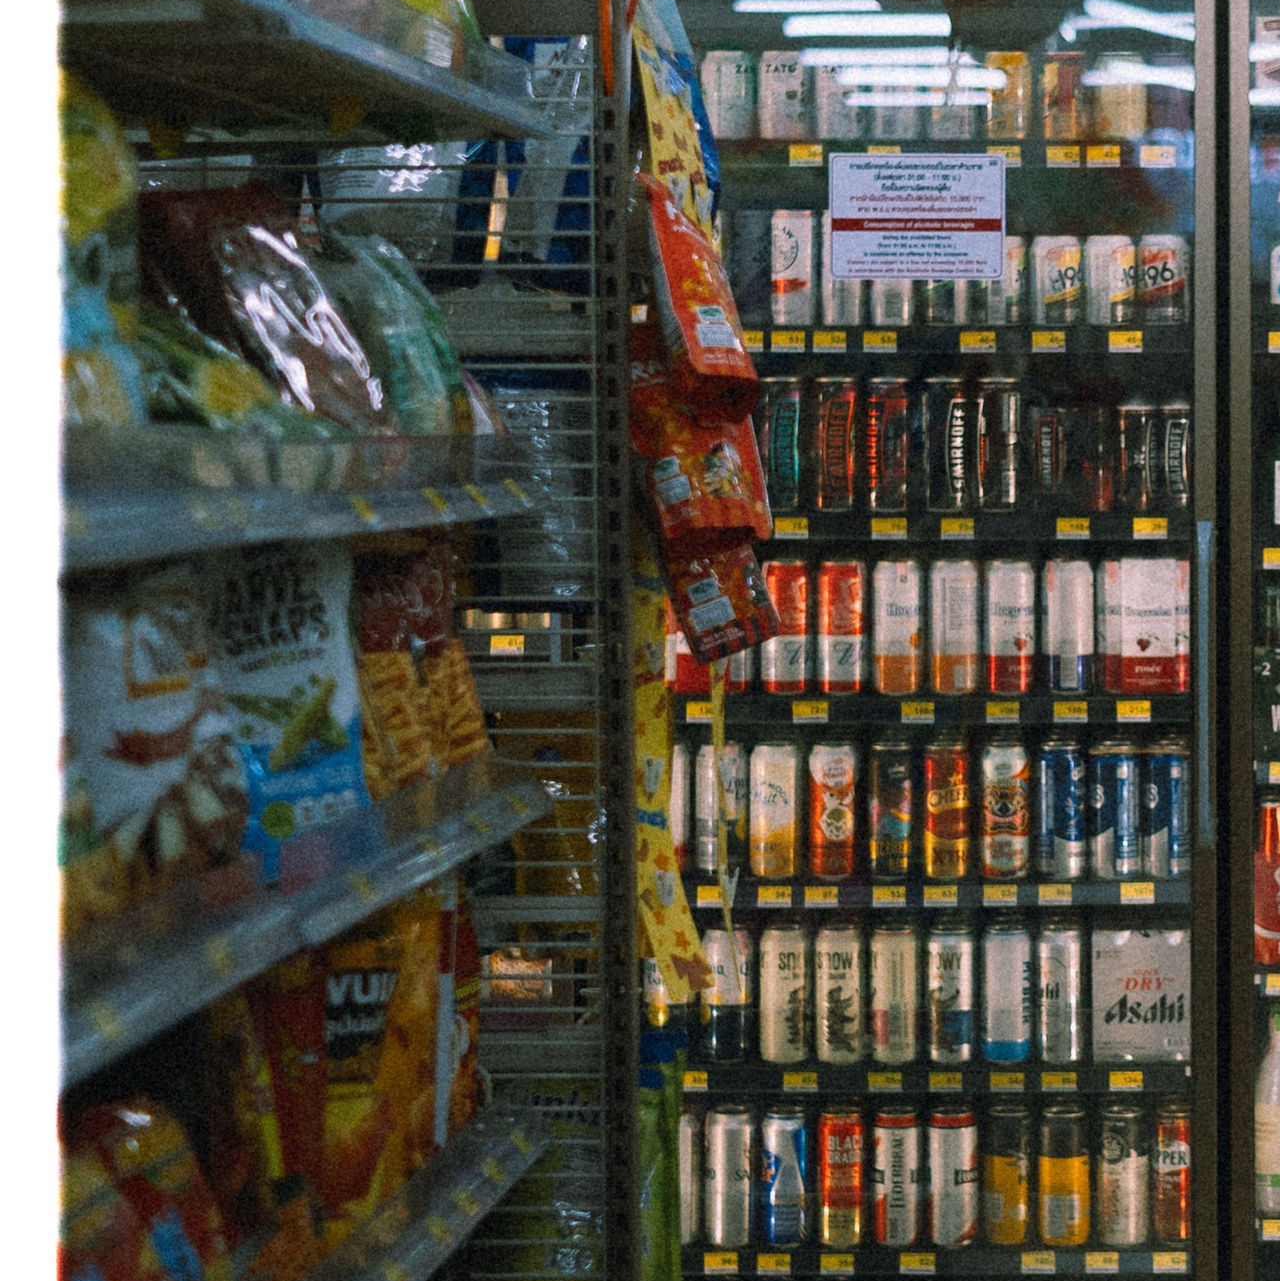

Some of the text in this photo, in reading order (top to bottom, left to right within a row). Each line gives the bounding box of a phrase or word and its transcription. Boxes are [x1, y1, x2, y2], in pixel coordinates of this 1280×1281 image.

[1262, 662, 1272, 677] 2
[1123, 975, 1166, 991] DRY
[1104, 993, 1186, 1025] Asahi
